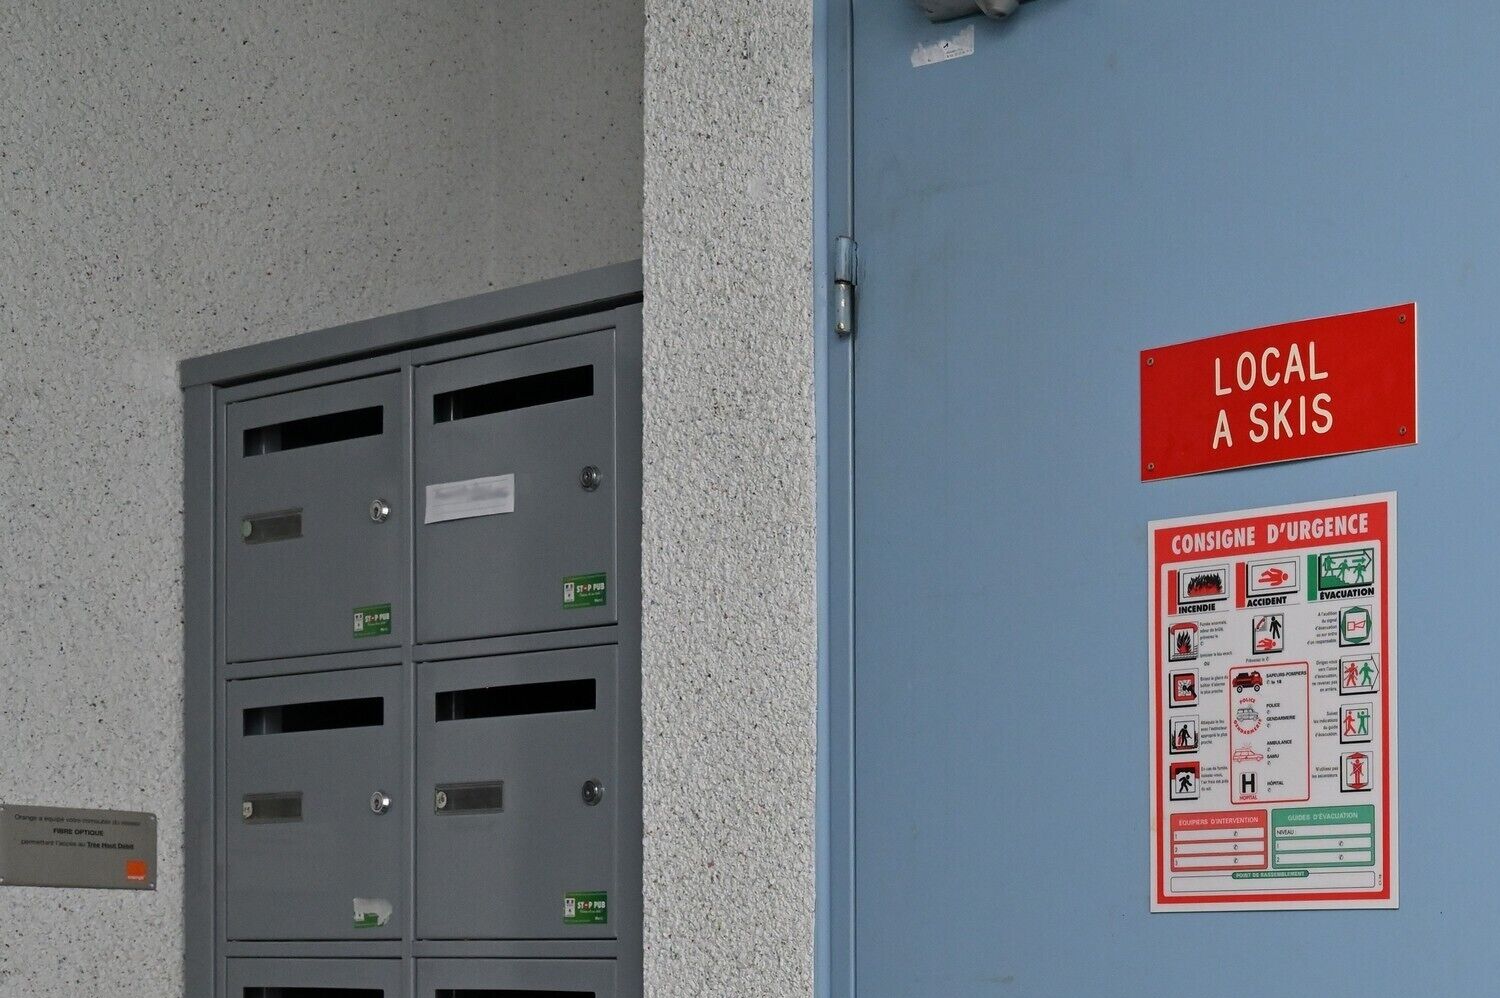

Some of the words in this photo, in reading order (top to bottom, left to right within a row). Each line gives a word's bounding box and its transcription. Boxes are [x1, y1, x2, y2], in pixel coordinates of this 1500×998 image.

[1215, 341, 1328, 396] LOCAL
[1212, 409, 1232, 450] A
[1249, 392, 1333, 443] SKIS
[1172, 526, 1255, 555] CONSIGNE
[1267, 513, 1368, 546] D'URGENCE
[1319, 587, 1375, 600] ÉVACUATION
[1178, 603, 1216, 614] INCENDIE
[1246, 596, 1287, 608] ACCIDENT
[1242, 773, 1255, 793] H
[1210, 816, 1258, 825] D'INTERVENTION
